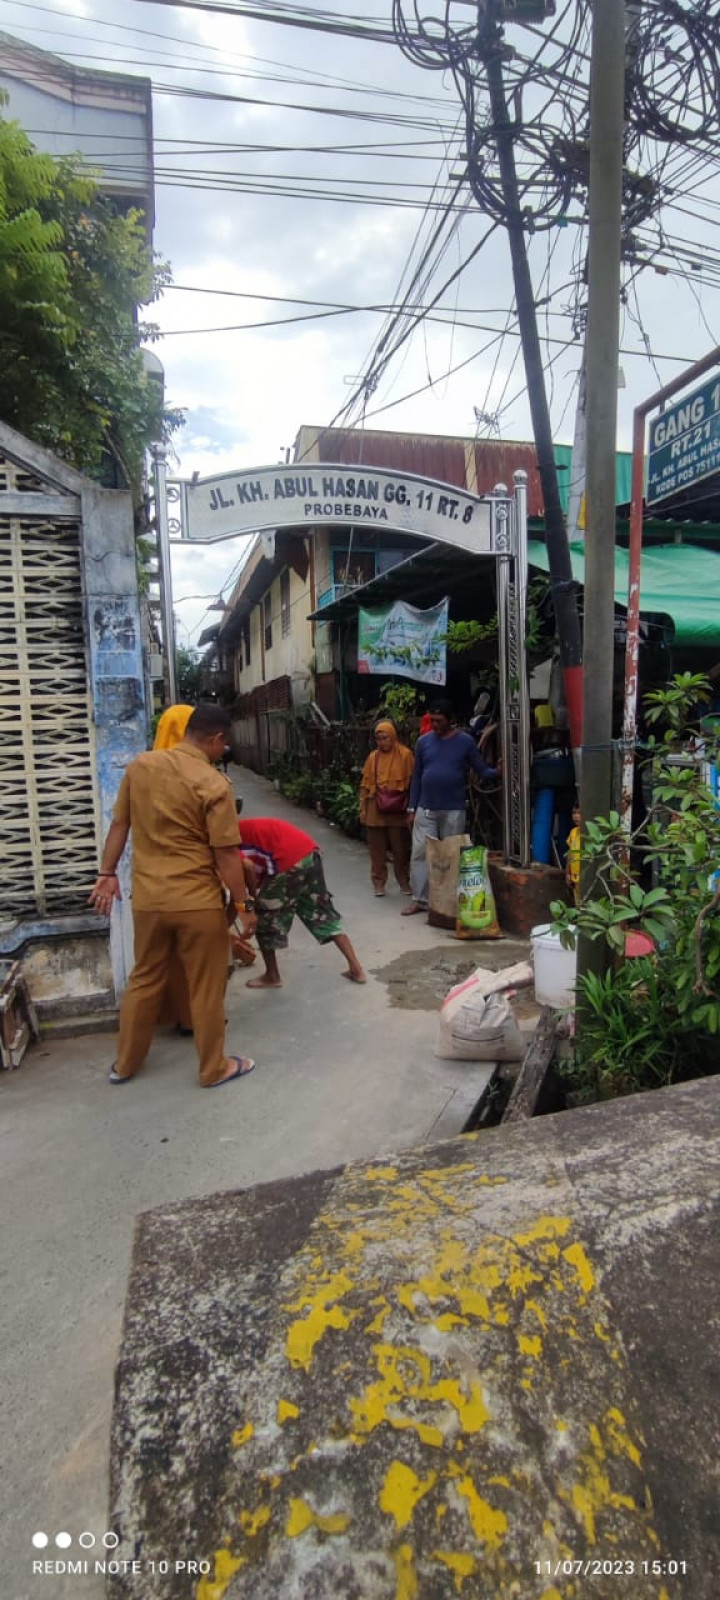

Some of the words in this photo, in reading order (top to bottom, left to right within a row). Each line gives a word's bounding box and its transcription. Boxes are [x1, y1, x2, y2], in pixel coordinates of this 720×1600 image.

[654, 396, 705, 447] GANG
[671, 421, 711, 459] RT.21
[678, 450, 699, 469] ABUL
[678, 466, 694, 483] POS
[209, 489, 235, 510] JL.
[236, 481, 269, 502] KH.
[274, 478, 318, 499] ABUL
[322, 477, 380, 500] HASAN
[383, 485, 411, 506] GG.
[416, 489, 433, 511] 11
[437, 499, 459, 520] RT.
[462, 506, 474, 524] 8
[304, 503, 388, 520] PROBEBAYA
